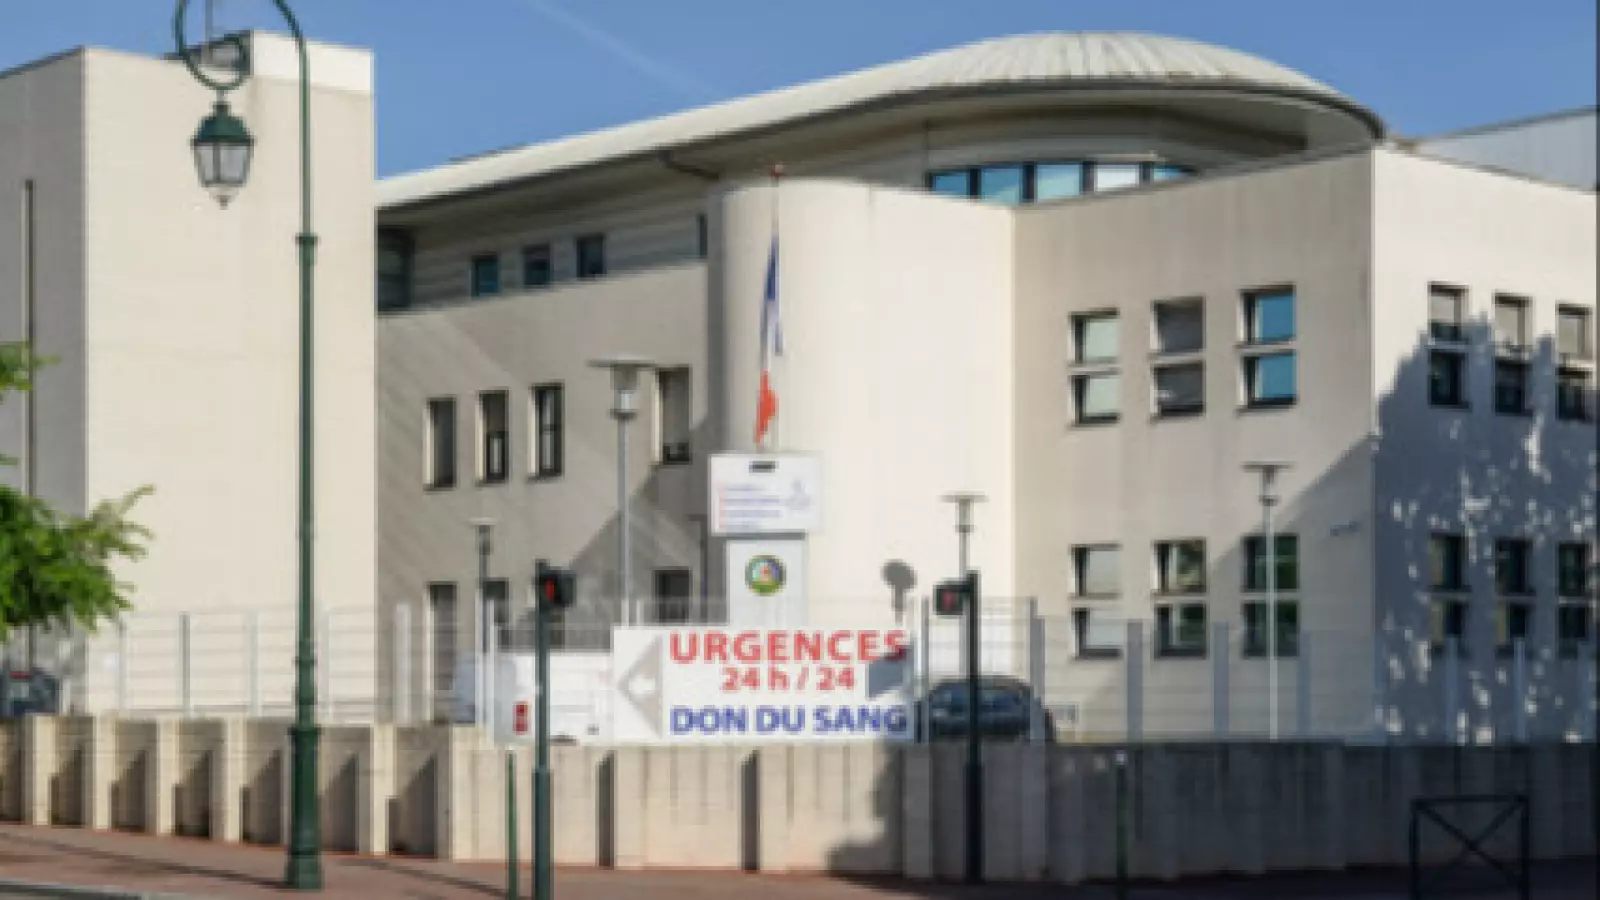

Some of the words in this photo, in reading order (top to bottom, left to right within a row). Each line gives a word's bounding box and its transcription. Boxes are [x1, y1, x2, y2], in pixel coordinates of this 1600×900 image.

[670, 630, 907, 663] URGENCES
[721, 667, 760, 691] 24
[767, 667, 790, 691] h
[797, 668, 809, 691] /
[816, 667, 856, 691] 24
[670, 705, 747, 735] DON
[756, 705, 806, 735] DU
[813, 705, 908, 735] SANG
